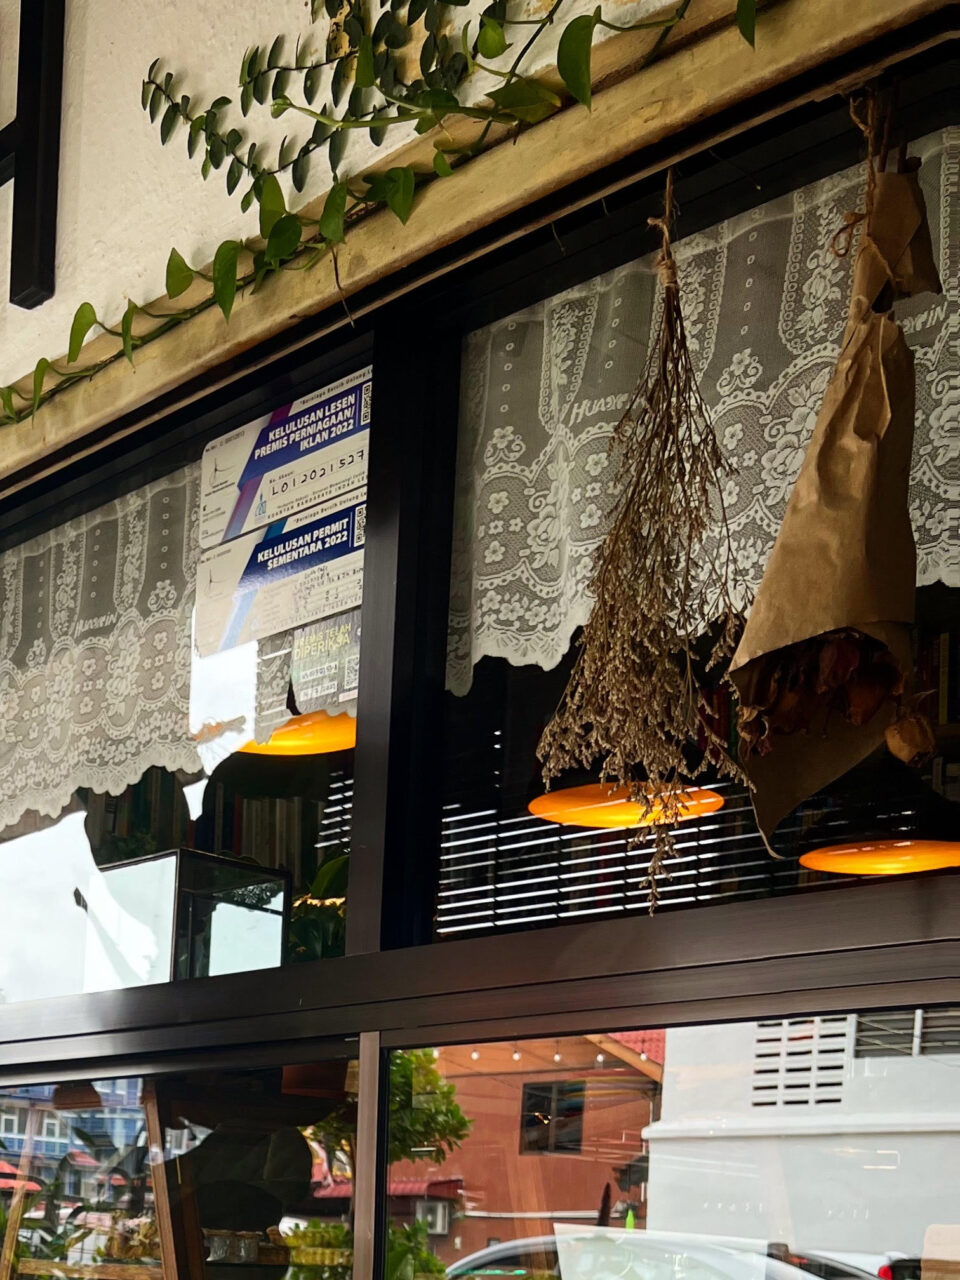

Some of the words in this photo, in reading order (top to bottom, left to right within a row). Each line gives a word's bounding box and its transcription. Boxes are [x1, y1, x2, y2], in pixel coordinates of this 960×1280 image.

[268, 408, 324, 442] KELULUSAN
[325, 393, 356, 417] LESEN
[300, 429, 330, 451] IKLAN
[330, 419, 355, 438] 2022
[254, 436, 289, 460] PREMIS
[257, 532, 312, 563] KELULUSAN
[312, 518, 349, 543] PERMIT
[267, 541, 323, 571] SEMENTARA
[323, 530, 348, 549] 2022
